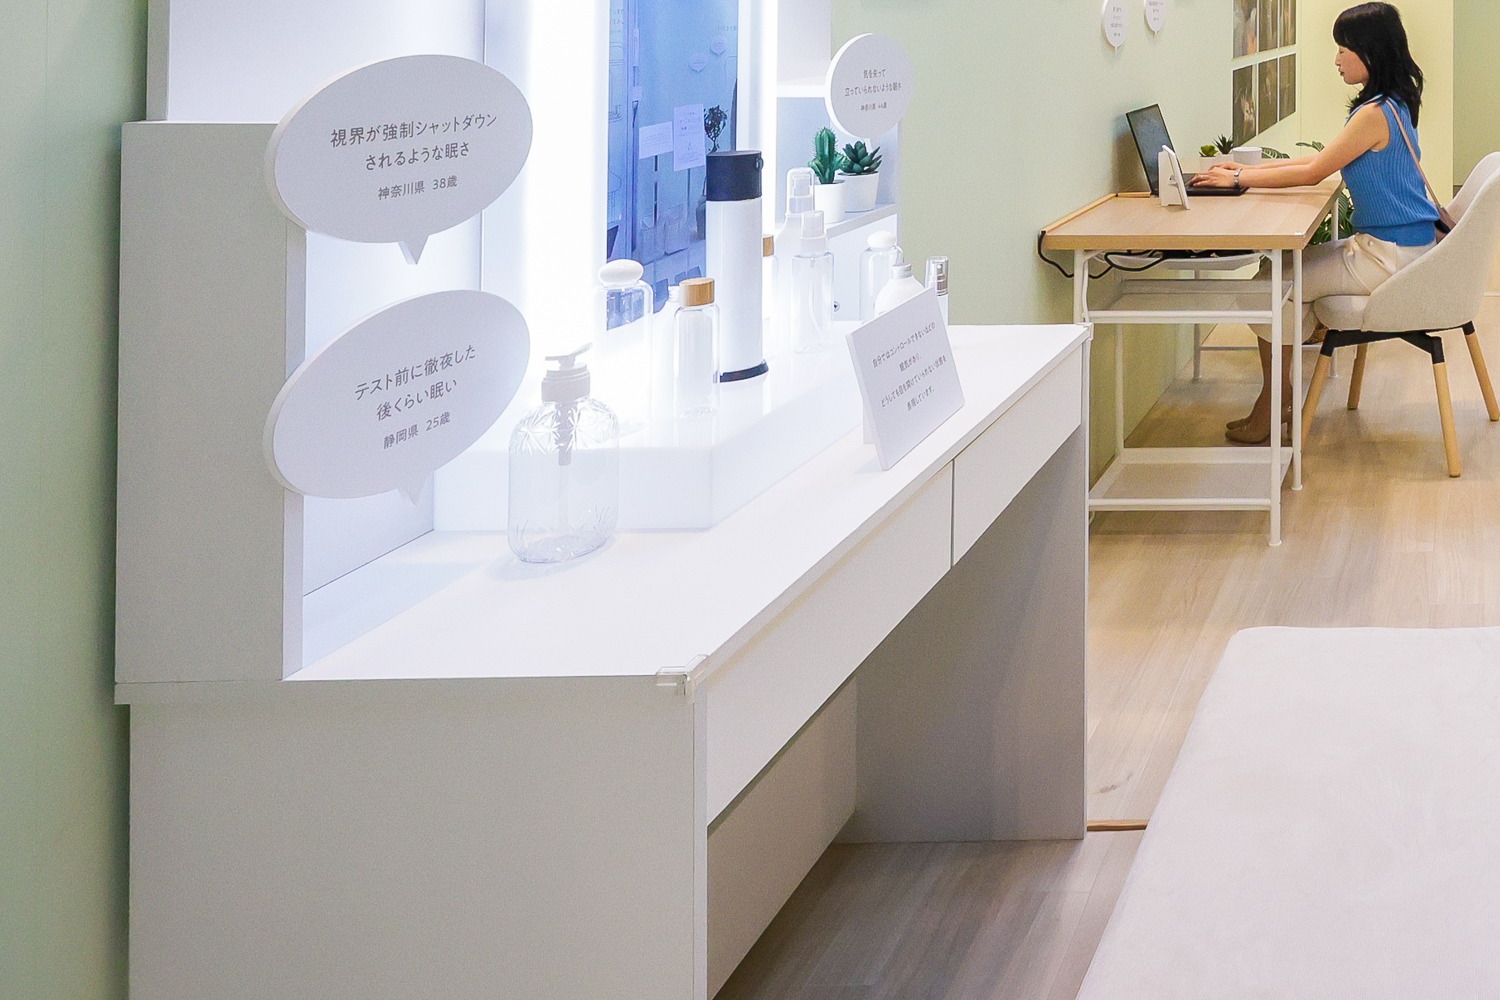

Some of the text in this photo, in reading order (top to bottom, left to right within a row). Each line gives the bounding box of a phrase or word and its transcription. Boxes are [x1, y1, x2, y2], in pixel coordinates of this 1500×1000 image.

[330, 113, 497, 148] 視界が強制シャットダウン
[365, 141, 470, 171] されるような眠さ
[378, 175, 458, 201] 神奈川県 38歳
[354, 344, 476, 400] テスト前に徹夜した
[376, 379, 457, 421] 後くらい眠い
[383, 411, 451, 450] 静岡県 25歳
